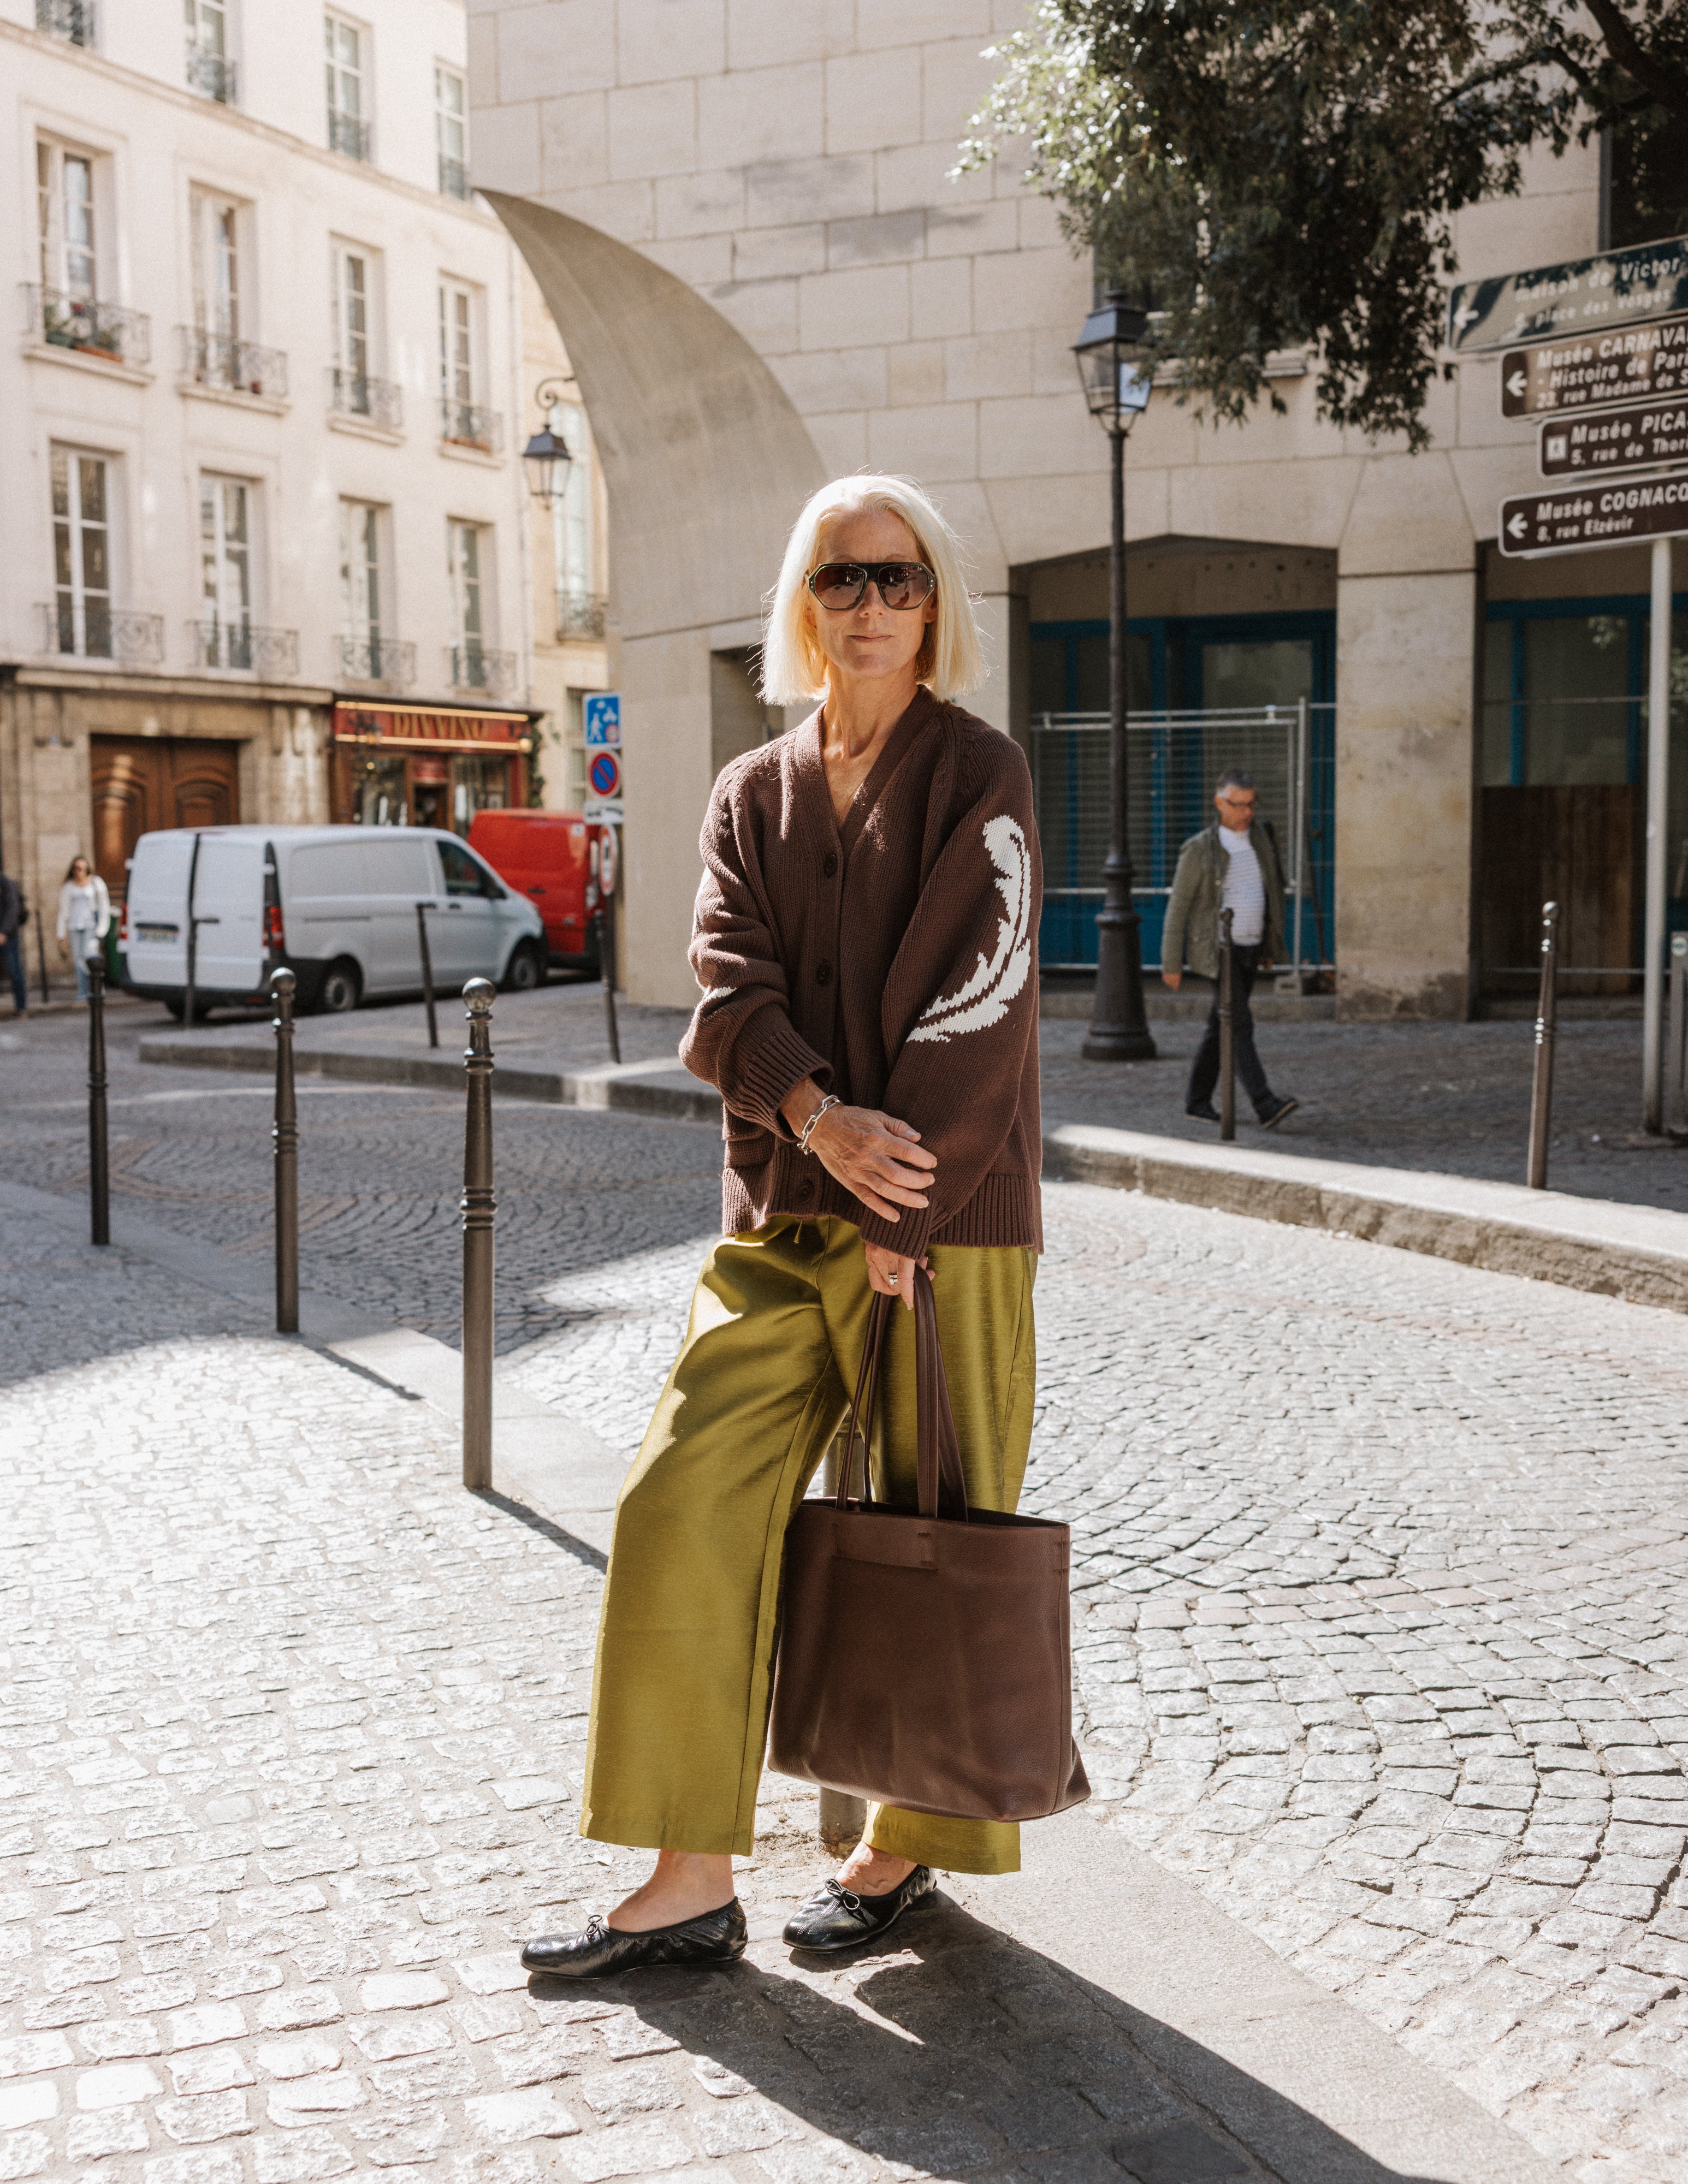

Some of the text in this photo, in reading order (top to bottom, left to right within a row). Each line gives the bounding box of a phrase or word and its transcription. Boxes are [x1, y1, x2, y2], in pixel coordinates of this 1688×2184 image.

[1621, 257, 1680, 281] Victor
[1536, 326, 1688, 369] Musée CARNAVA
[1550, 362, 1620, 389] Histoire
[1626, 357, 1648, 377] de
[1562, 389, 1588, 405] rue
[1590, 378, 1651, 400] Madame
[1656, 372, 1675, 389] de
[1570, 410, 1688, 445] Musée PICA
[1592, 447, 1619, 463] rue
[1625, 441, 1644, 459] de
[1536, 497, 1594, 522] Musée
[1555, 524, 1580, 540] rue
[1584, 514, 1634, 536] Elzévir
